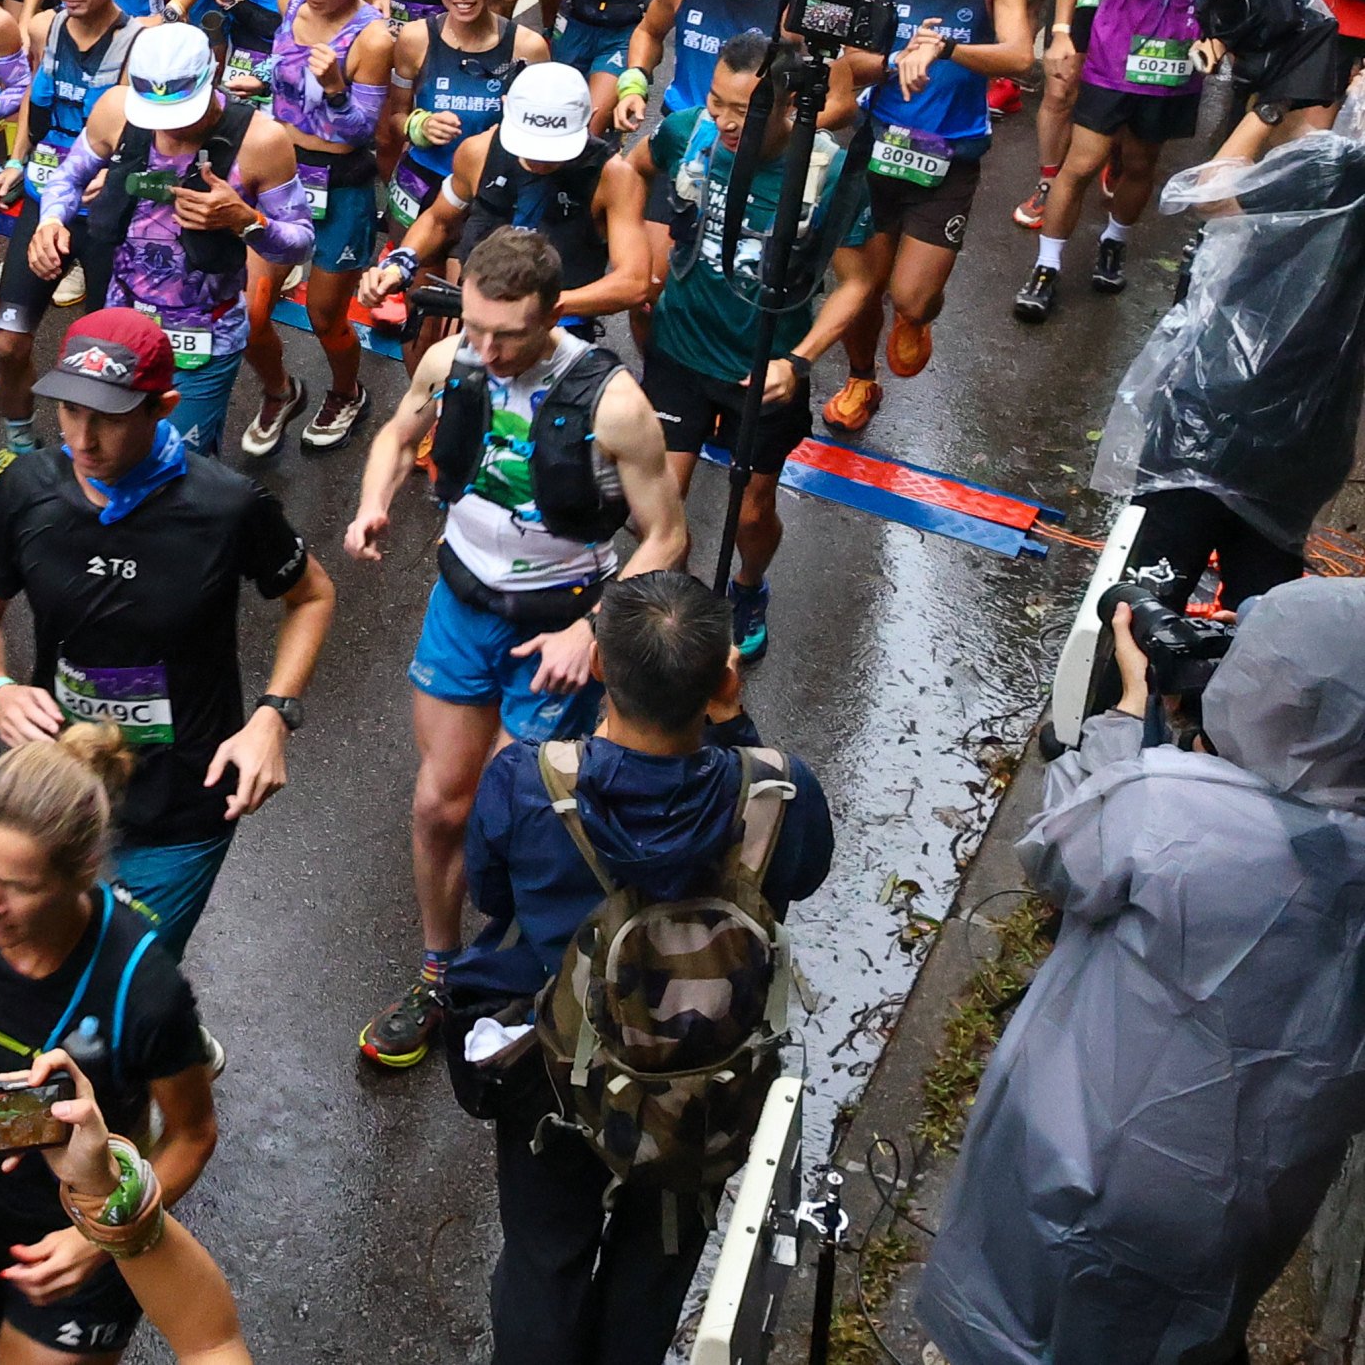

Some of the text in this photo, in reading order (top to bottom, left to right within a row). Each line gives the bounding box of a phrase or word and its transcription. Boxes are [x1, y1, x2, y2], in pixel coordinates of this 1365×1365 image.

[683, 29, 720, 54] 富途
[1138, 57, 1187, 77] 6021B
[434, 93, 501, 112] 富途證券
[522, 111, 569, 130] HOKA
[881, 145, 939, 175] 8091D
[108, 558, 138, 580] T8
